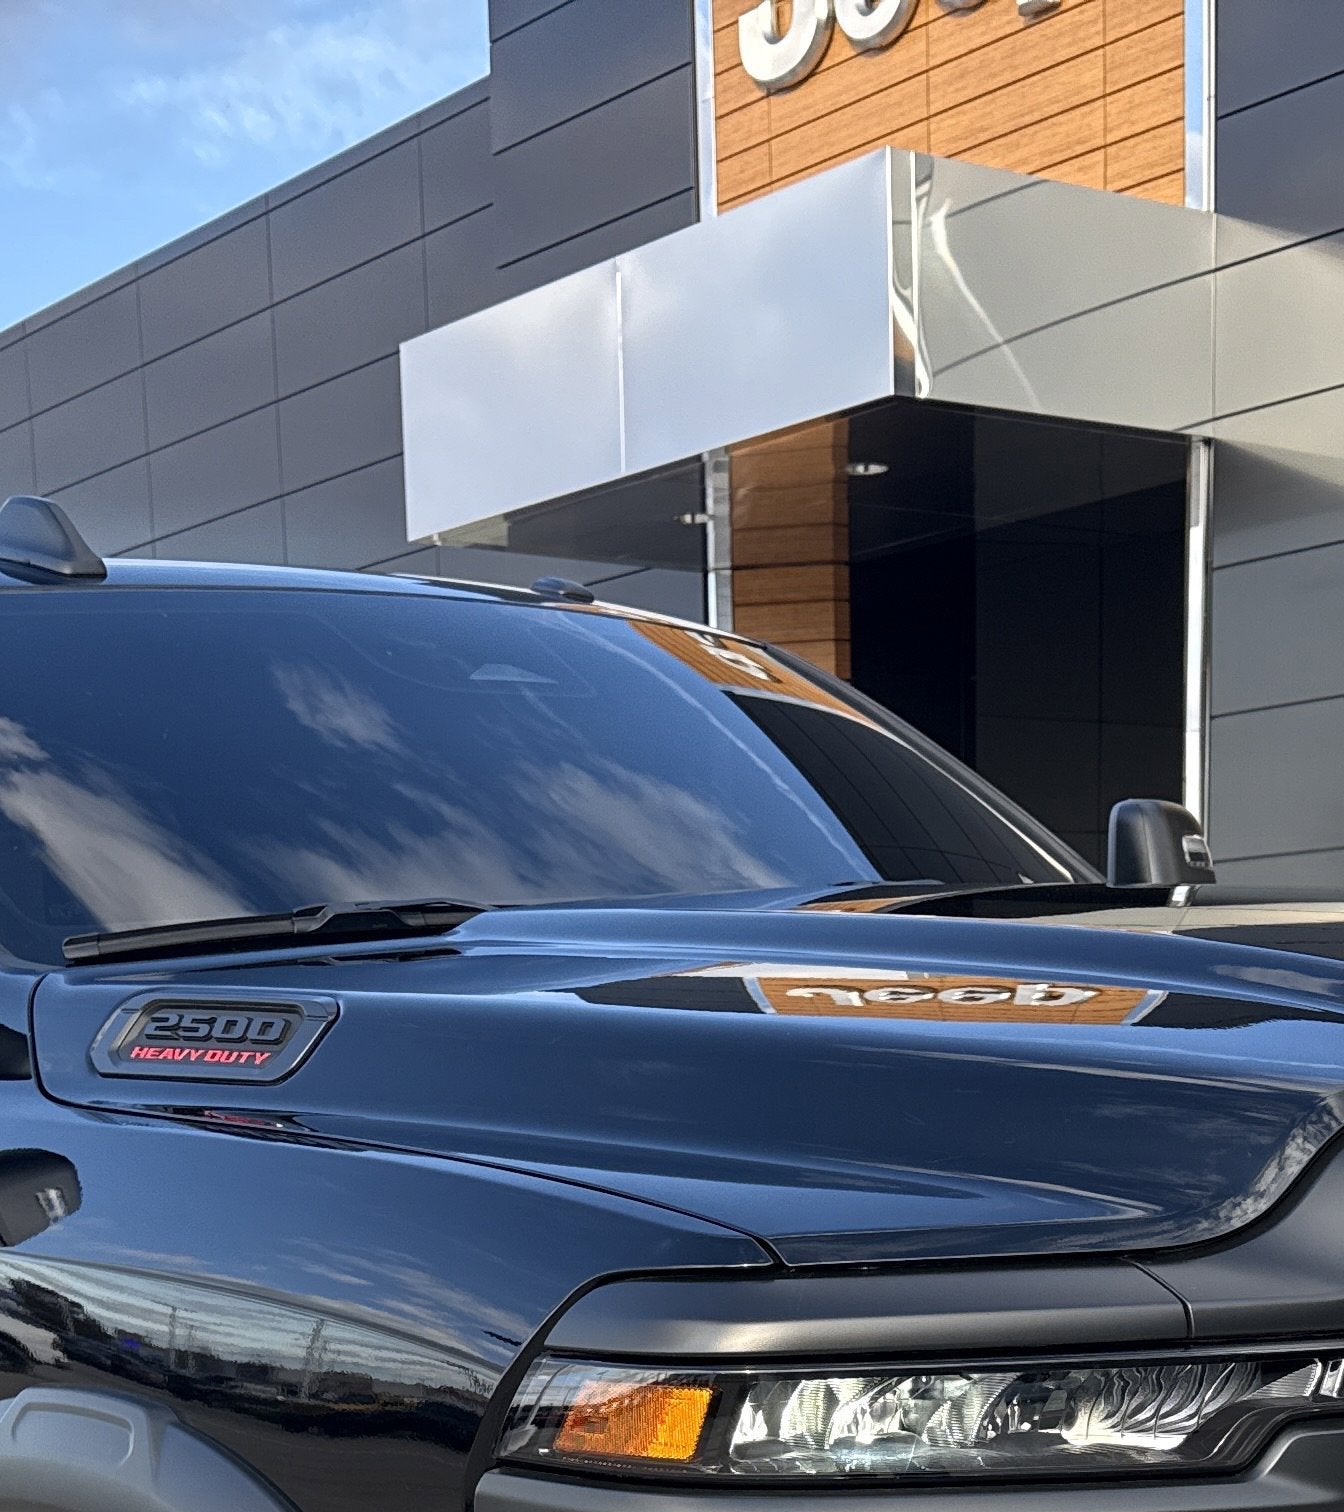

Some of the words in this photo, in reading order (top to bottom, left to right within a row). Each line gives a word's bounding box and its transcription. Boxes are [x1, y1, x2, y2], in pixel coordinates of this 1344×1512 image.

[144, 1013, 293, 1045] 2500
[130, 1046, 205, 1062] HEAVY
[205, 1049, 271, 1065] DUTY
